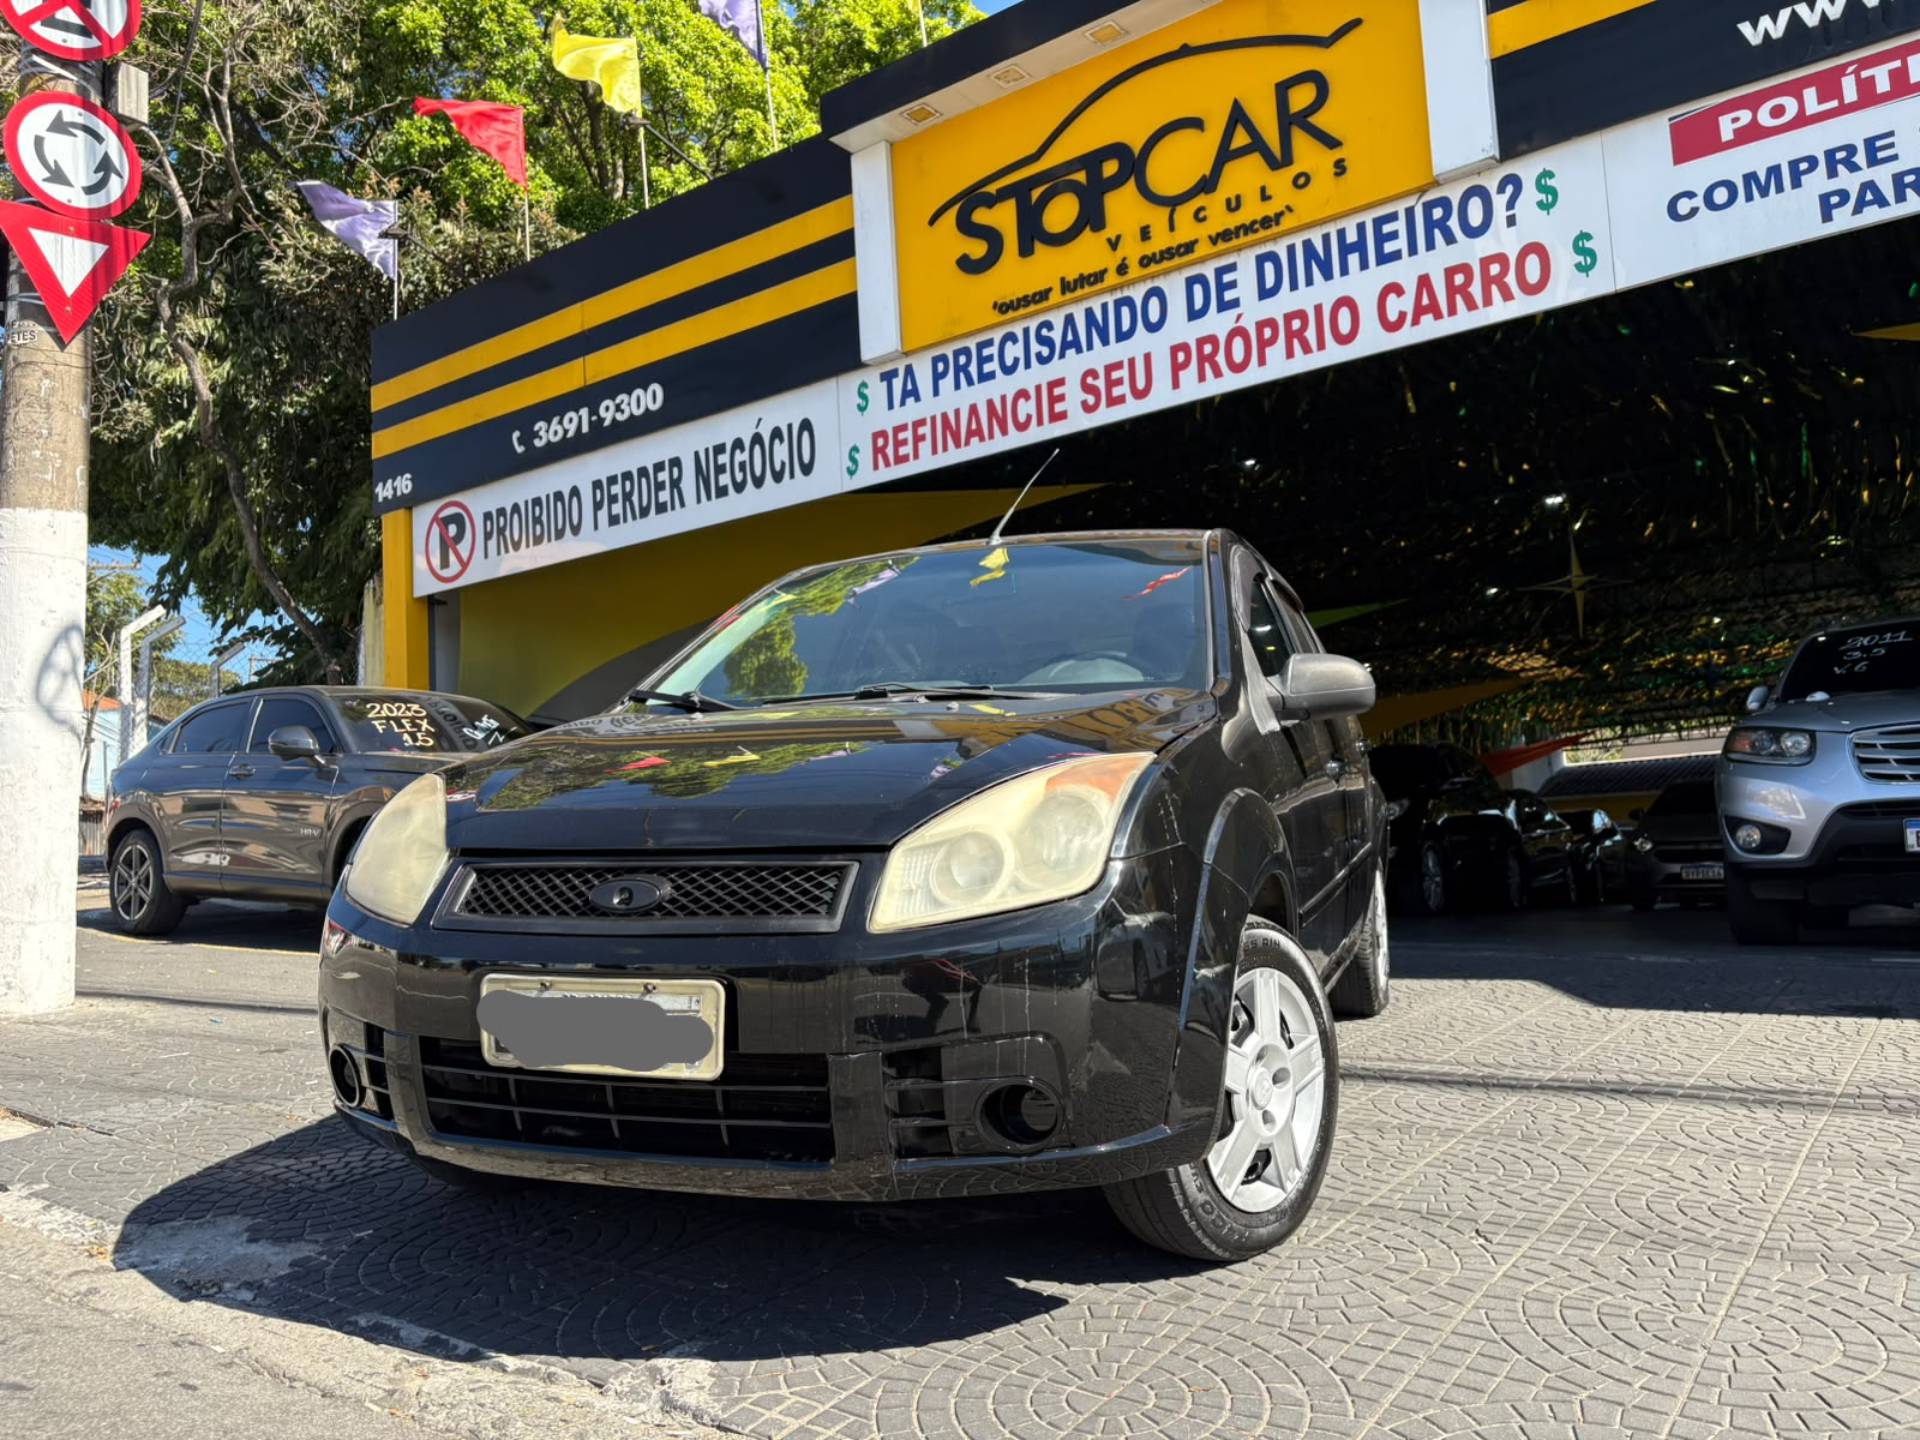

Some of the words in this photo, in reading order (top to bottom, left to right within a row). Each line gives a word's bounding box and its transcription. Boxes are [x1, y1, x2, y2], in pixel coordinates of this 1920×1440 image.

[1106, 157, 1348, 252] VEÍCULOS
[1666, 130, 1900, 223] COMPRE
[880, 363, 921, 411] TA
[931, 285, 1168, 398] PRECISANDO
[1185, 262, 1241, 323] DE
[1255, 172, 1523, 301] DINHEIRO?
[1060, 265, 1108, 296] lutar
[1116, 252, 1129, 277] é
[1138, 236, 1199, 268] ousar
[871, 376, 1068, 472] REFINANCIE
[1079, 352, 1153, 415] SEU
[1169, 295, 1361, 390] PRÓPRIO
[1376, 241, 1551, 333] CARRO
[533, 382, 664, 448] 3691-9300
[375, 473, 413, 502] 1416
[483, 485, 583, 560] PROIBIDO
[592, 455, 686, 532] PERDER
[694, 417, 817, 504] NEGÓCIO
[366, 702, 427, 718] 2023
[371, 718, 435, 734] FLEX
